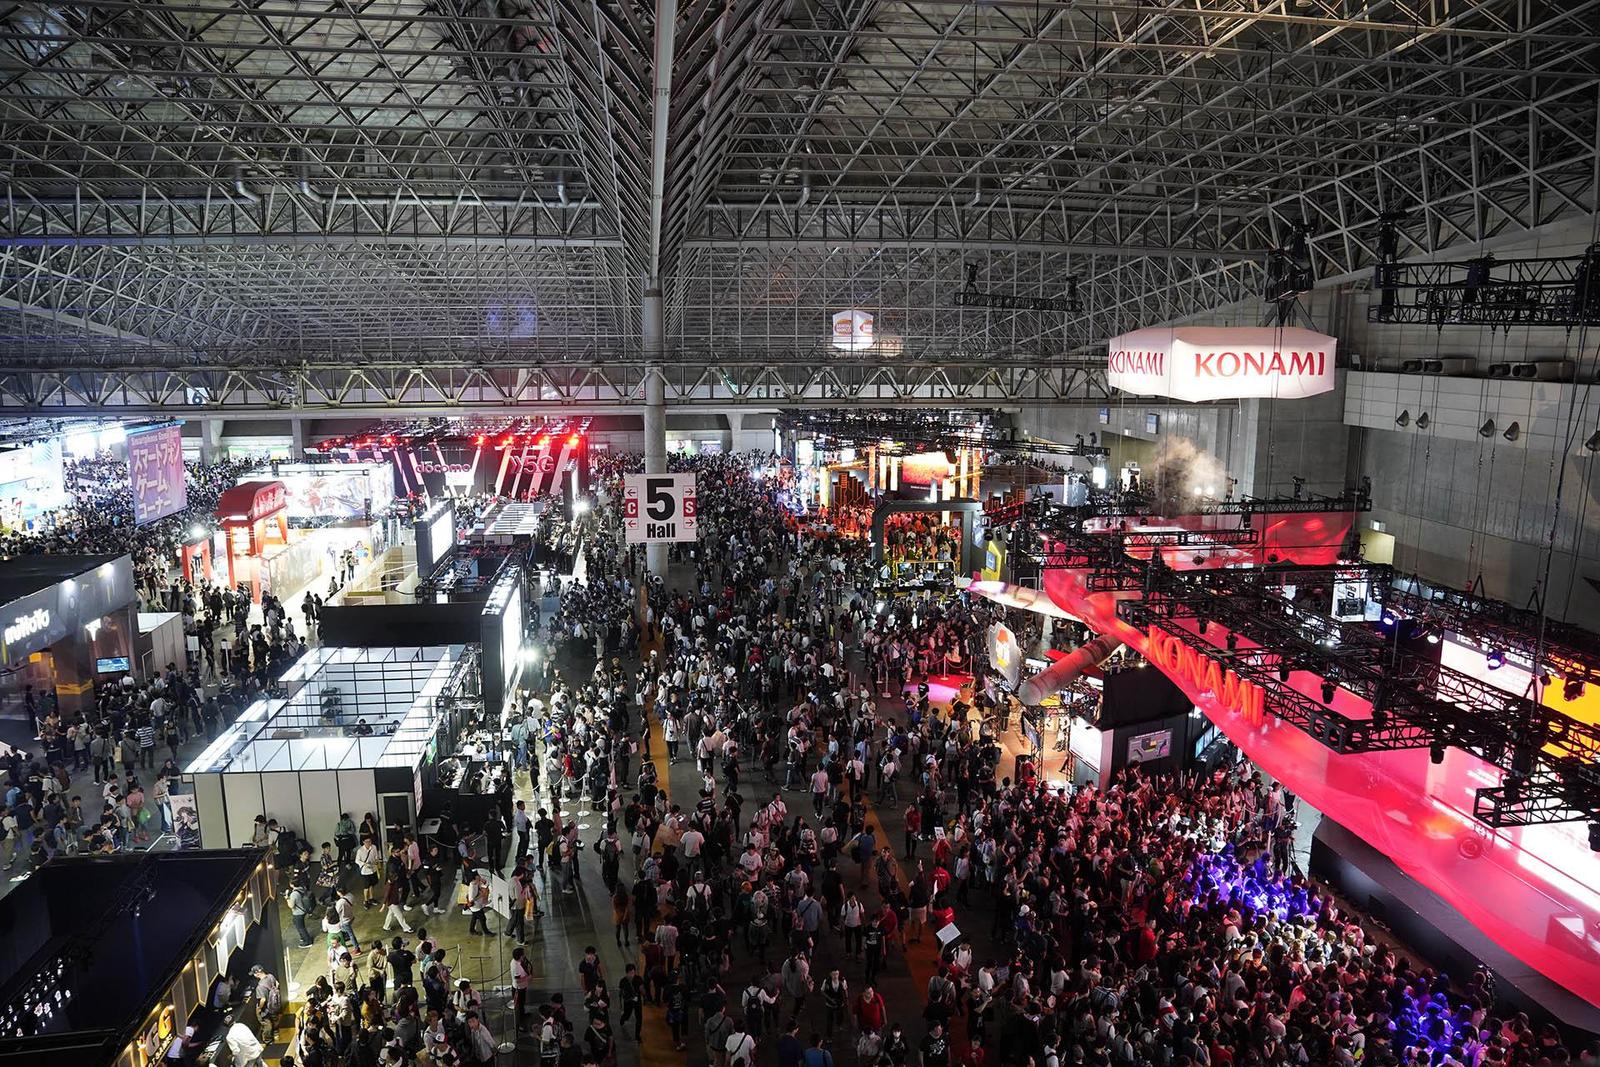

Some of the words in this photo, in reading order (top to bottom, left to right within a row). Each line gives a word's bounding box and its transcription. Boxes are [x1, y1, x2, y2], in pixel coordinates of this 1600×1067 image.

[1109, 351, 1164, 376] KONAMI
[1195, 352, 1325, 377] KONAMI
[133, 443, 180, 473] スマートフォン
[416, 462, 471, 473] docomo
[523, 456, 554, 473] 5G
[136, 471, 168, 500] ゲーム
[138, 498, 172, 519] コーナー
[627, 502, 636, 515] C
[646, 478, 676, 521] 5
[685, 501, 694, 514] S
[646, 523, 676, 538] Hall
[1148, 624, 1264, 728] KONAMI
